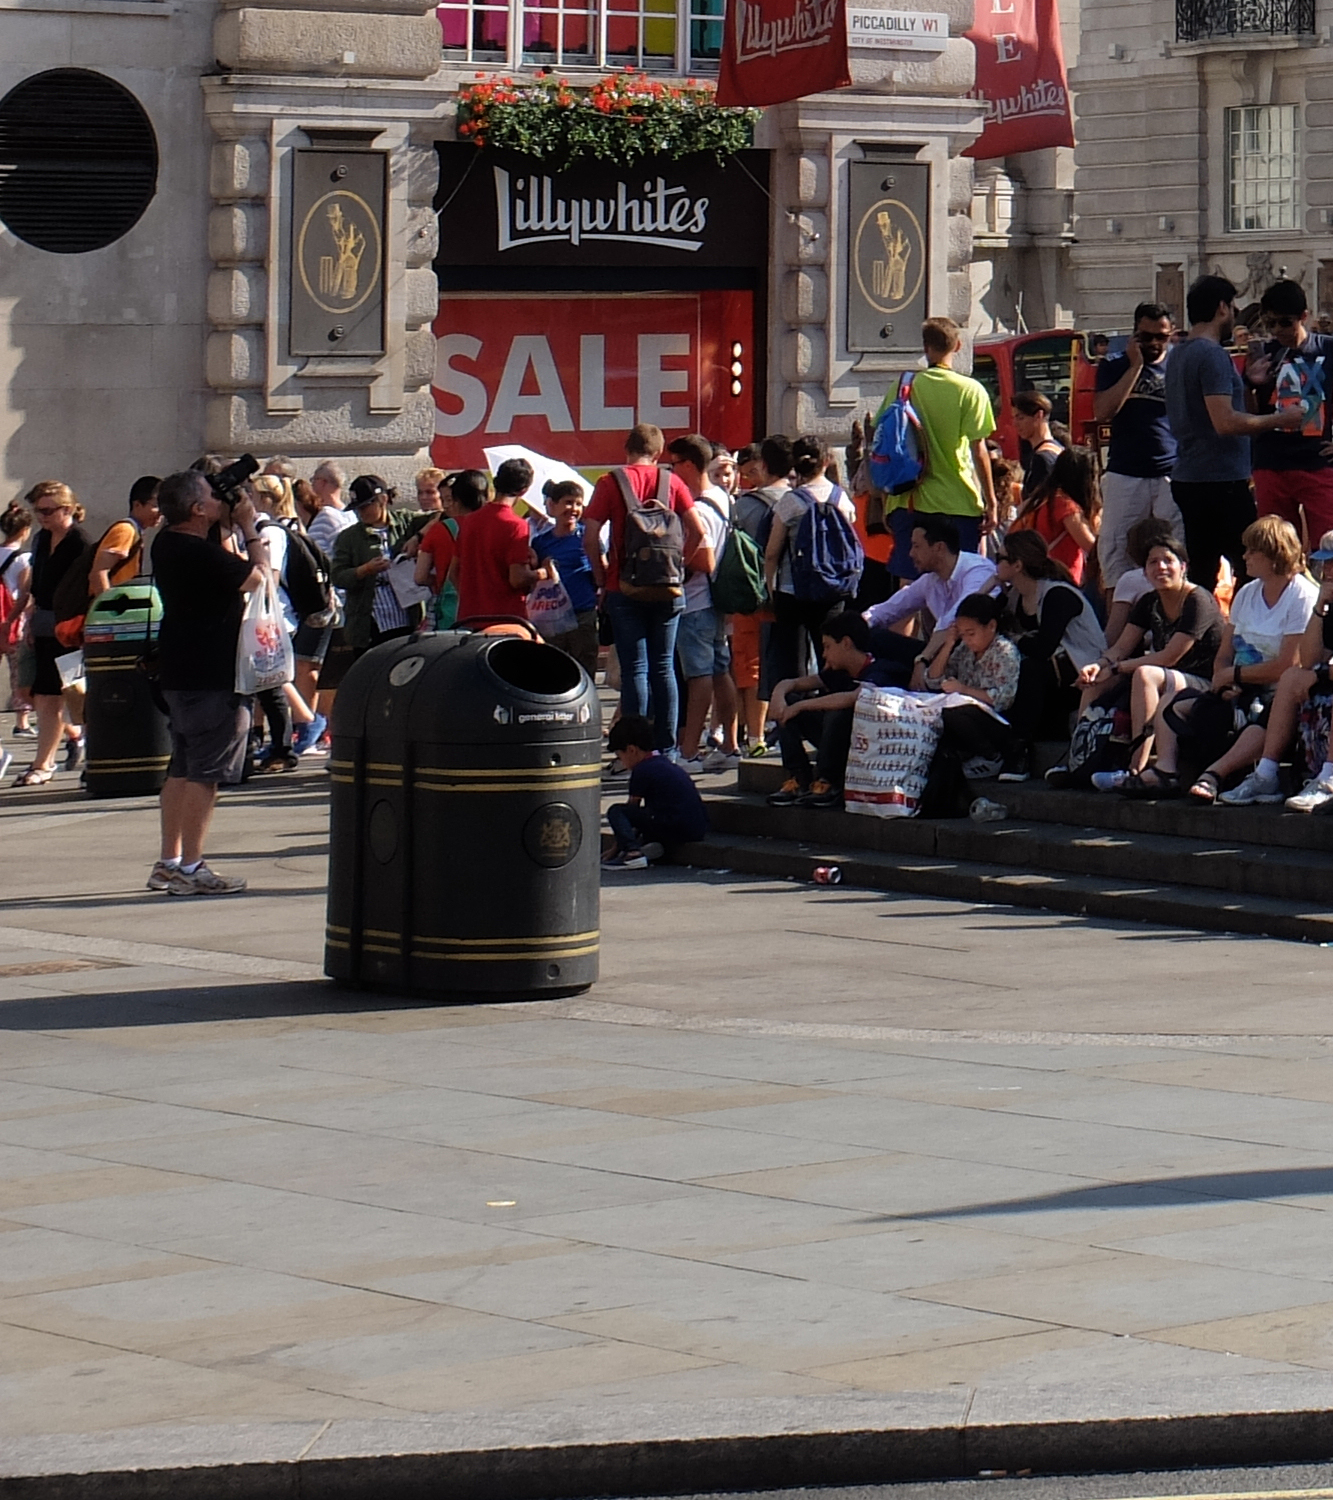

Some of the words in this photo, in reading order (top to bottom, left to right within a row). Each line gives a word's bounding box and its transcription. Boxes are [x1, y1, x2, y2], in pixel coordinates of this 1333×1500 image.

[852, 15, 916, 31] PICCADILLY
[922, 18, 939, 33] W1
[966, 79, 1066, 125] ywhites
[493, 165, 709, 252] Lillywhites
[434, 333, 690, 437] SALE
[518, 711, 554, 724] general
